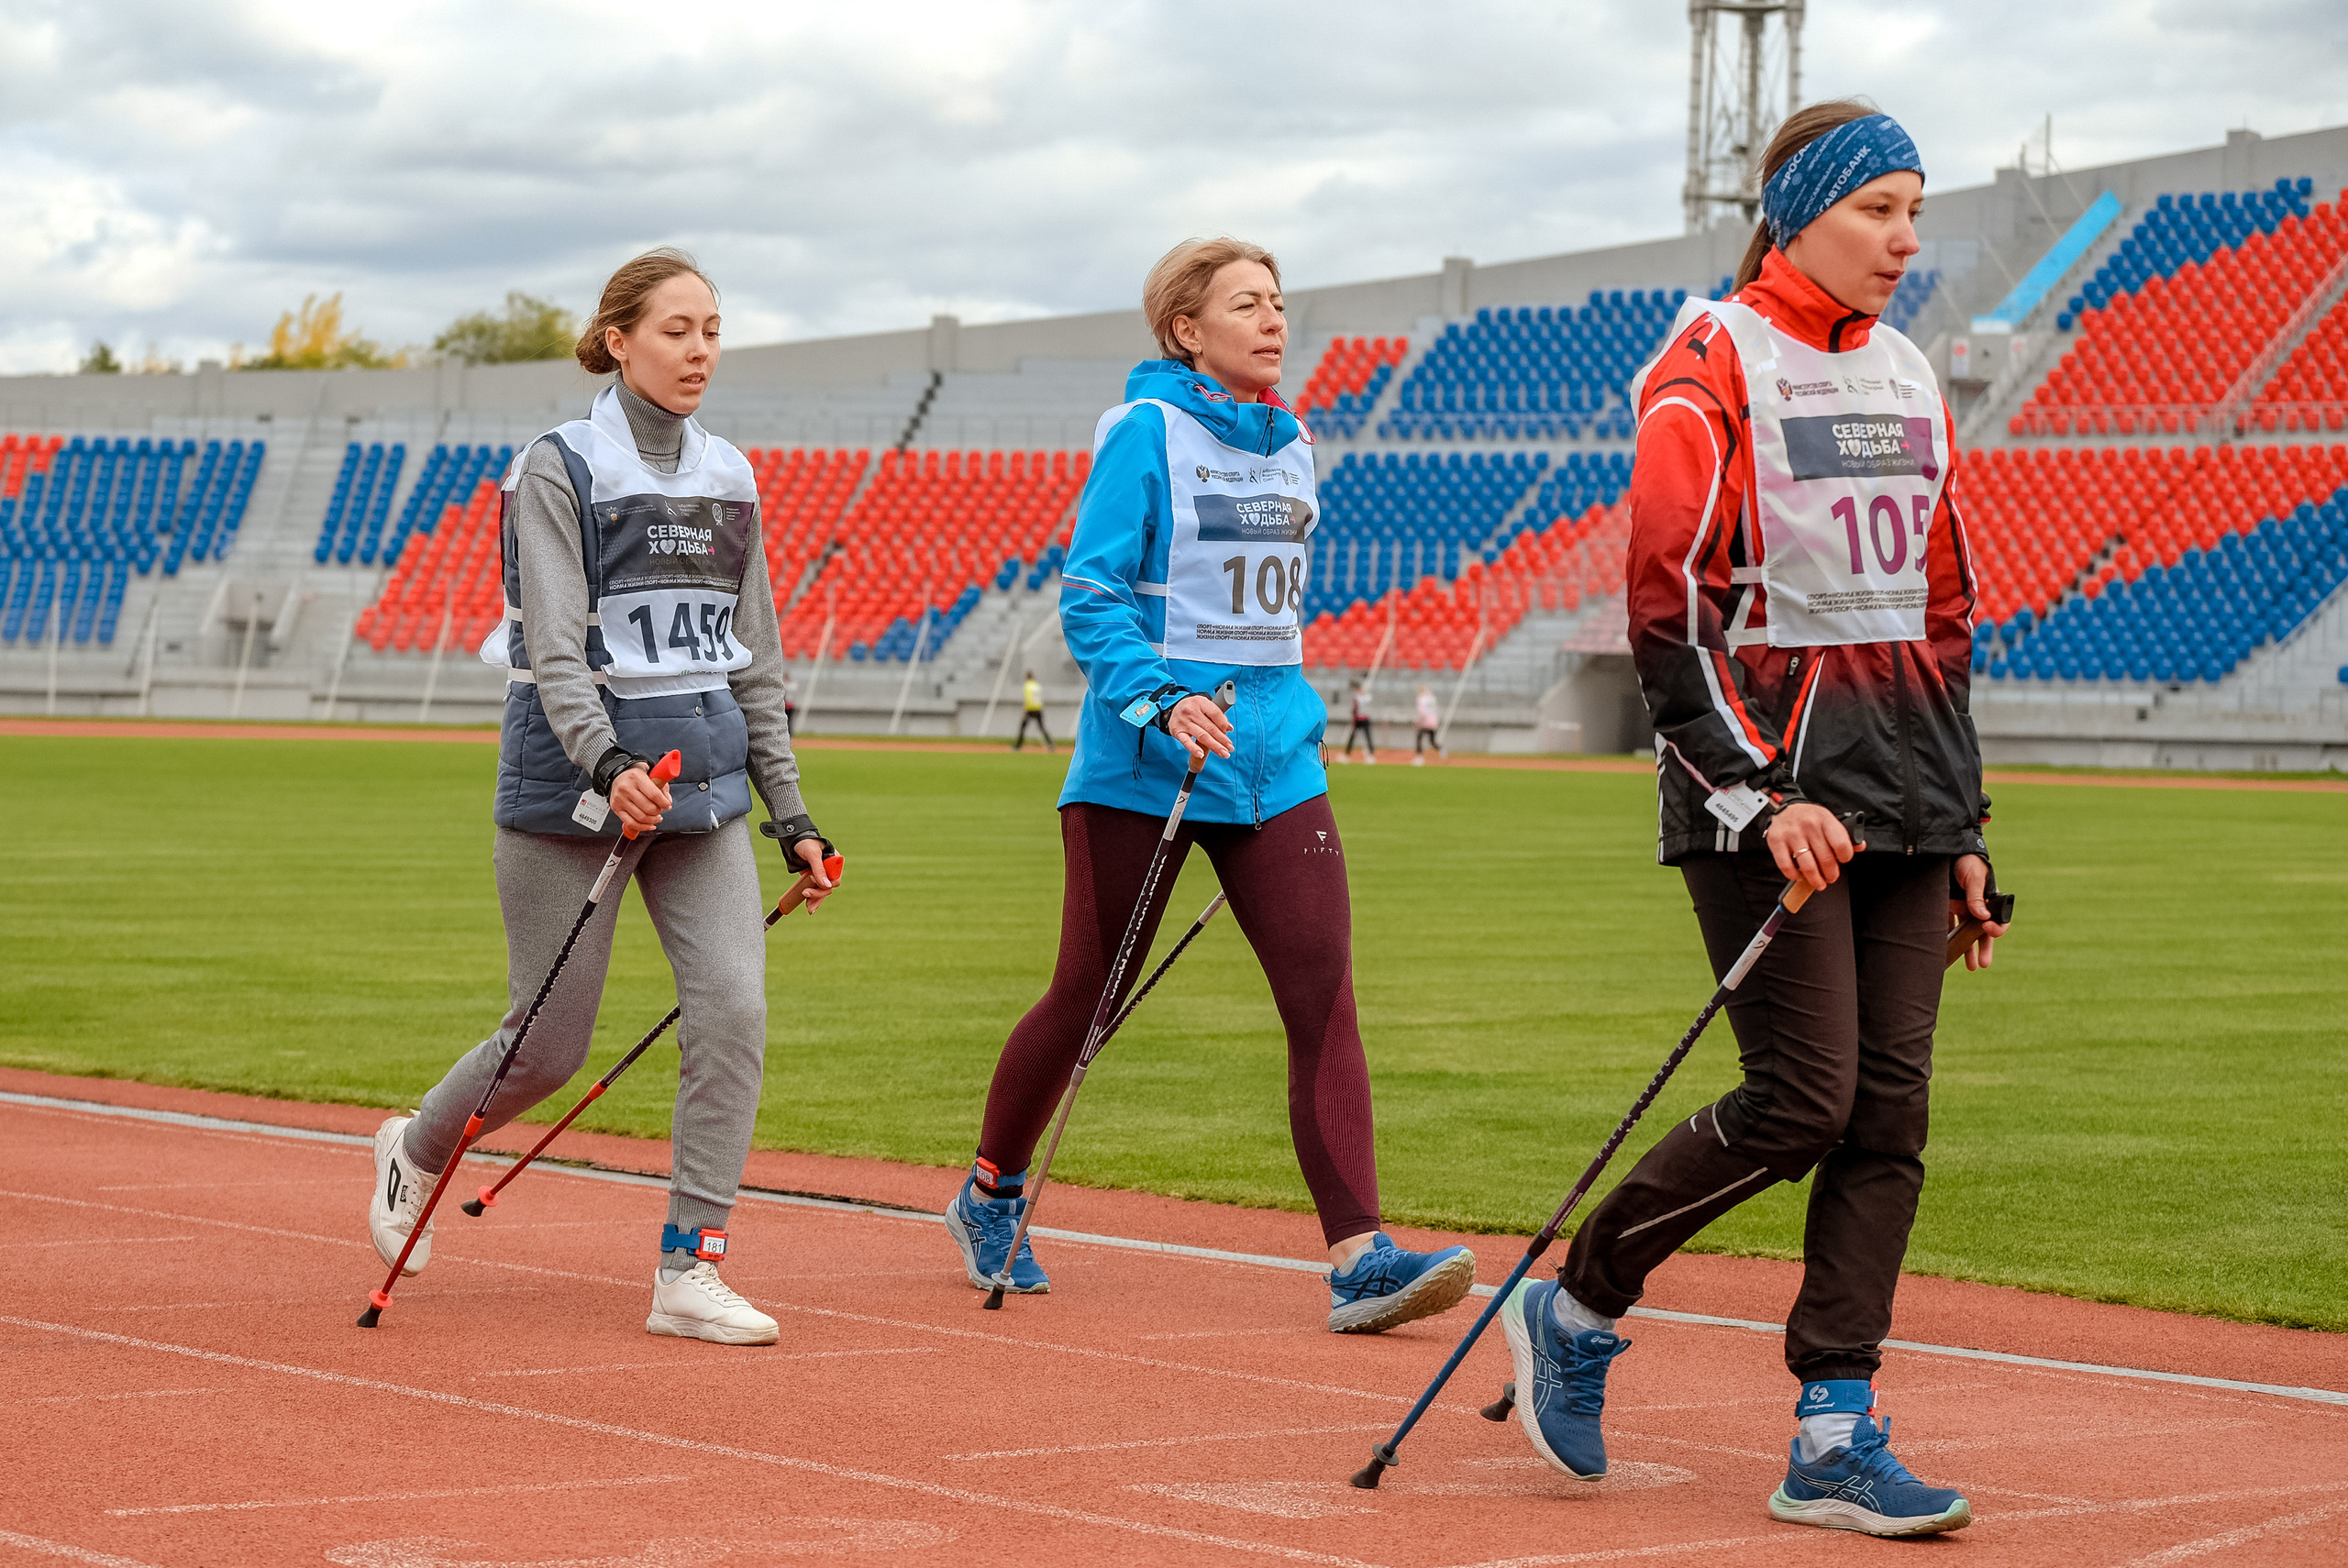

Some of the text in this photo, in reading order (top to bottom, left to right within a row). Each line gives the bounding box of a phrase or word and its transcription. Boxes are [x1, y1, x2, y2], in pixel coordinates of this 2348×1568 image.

[1832, 422, 1905, 439] СЕВЕРНАЯ
[1866, 459, 1891, 468] ОБРАЗ
[1235, 501, 1293, 513] СЕВЕРНАЯ
[647, 525, 712, 541] СЕВЕРНАЯ
[1831, 494, 1929, 575] 105
[1223, 556, 1301, 615] 108
[628, 602, 734, 663] 1459
[978, 1170, 991, 1183] 108
[707, 1242, 723, 1253] 181
